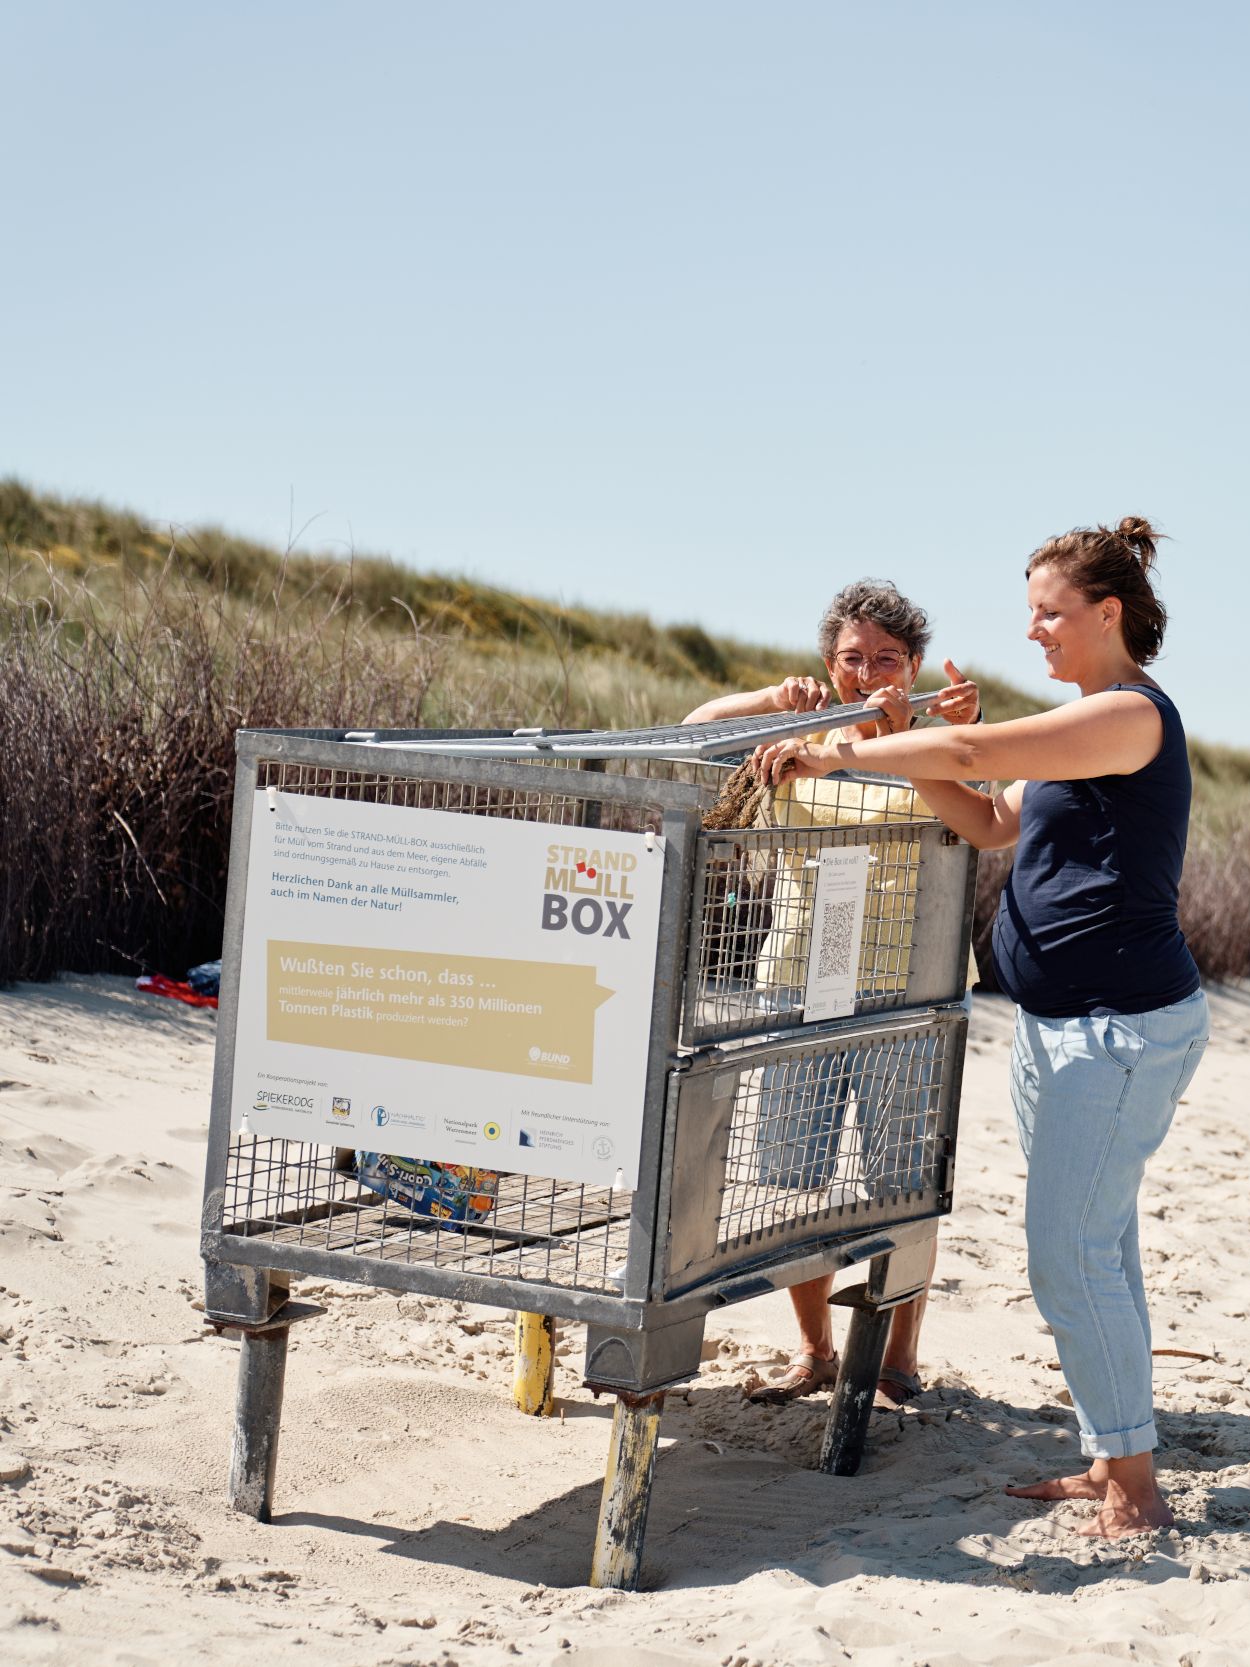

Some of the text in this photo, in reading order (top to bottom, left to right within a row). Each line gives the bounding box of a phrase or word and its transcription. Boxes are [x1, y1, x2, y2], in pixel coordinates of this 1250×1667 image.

[274, 835, 487, 868] für Müll vom Strand und aus dem Meer, eigene Abfälle
[275, 822, 485, 854] Bitte nutzen Sie die STRAND-MÜLL-BOX ausschließlich
[273, 848, 451, 879] sind ordnungsgemäß zu Hause zu entsorgen.
[546, 844, 638, 873] STRAND
[272, 872, 460, 905] Herzlichen Dank an alle Müllsammler,
[544, 862, 634, 900] MÜLL
[270, 888, 403, 912] auch im Namen der Natur!
[541, 893, 634, 940] BOX
[279, 956, 345, 976] Wußten
[351, 961, 374, 978] Sie
[379, 964, 432, 986] schon,
[438, 968, 475, 986] dass
[278, 999, 470, 1028] Tonnen Plastik produziert werden?
[279, 985, 543, 1015] mittlerweile jährlich mehr als 350 Millionen
[541, 1051, 571, 1065] BUND
[256, 1090, 315, 1109] SPIEKEROOG
